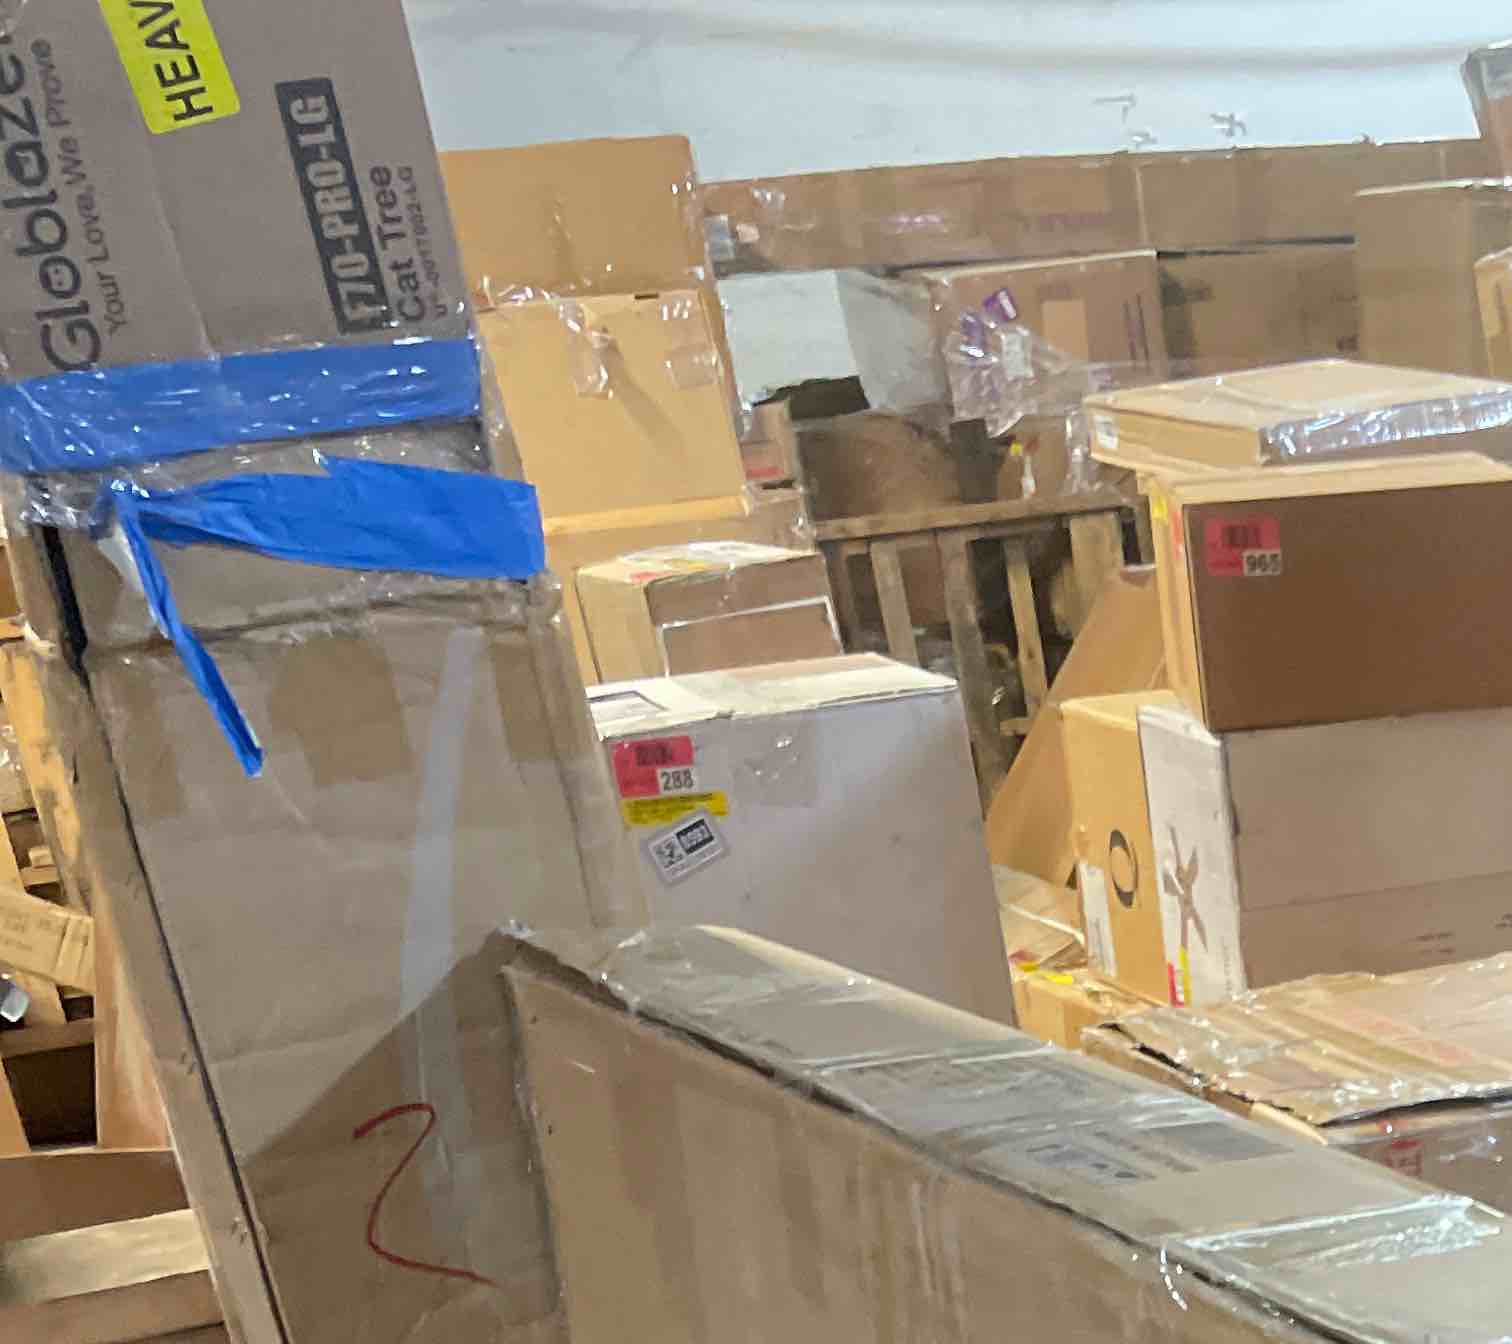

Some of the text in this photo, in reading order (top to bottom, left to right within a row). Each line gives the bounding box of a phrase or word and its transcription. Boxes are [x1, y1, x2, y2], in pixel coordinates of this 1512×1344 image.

[30, 38, 71, 128] Prove
[0, 32, 101, 372] Globlaze
[58, 137, 87, 186] We
[290, 94, 388, 322] F70-PRO-LG
[369, 166, 425, 321] Cat Tree
[96, 272, 128, 336] Your
[660, 769, 694, 791] 288
